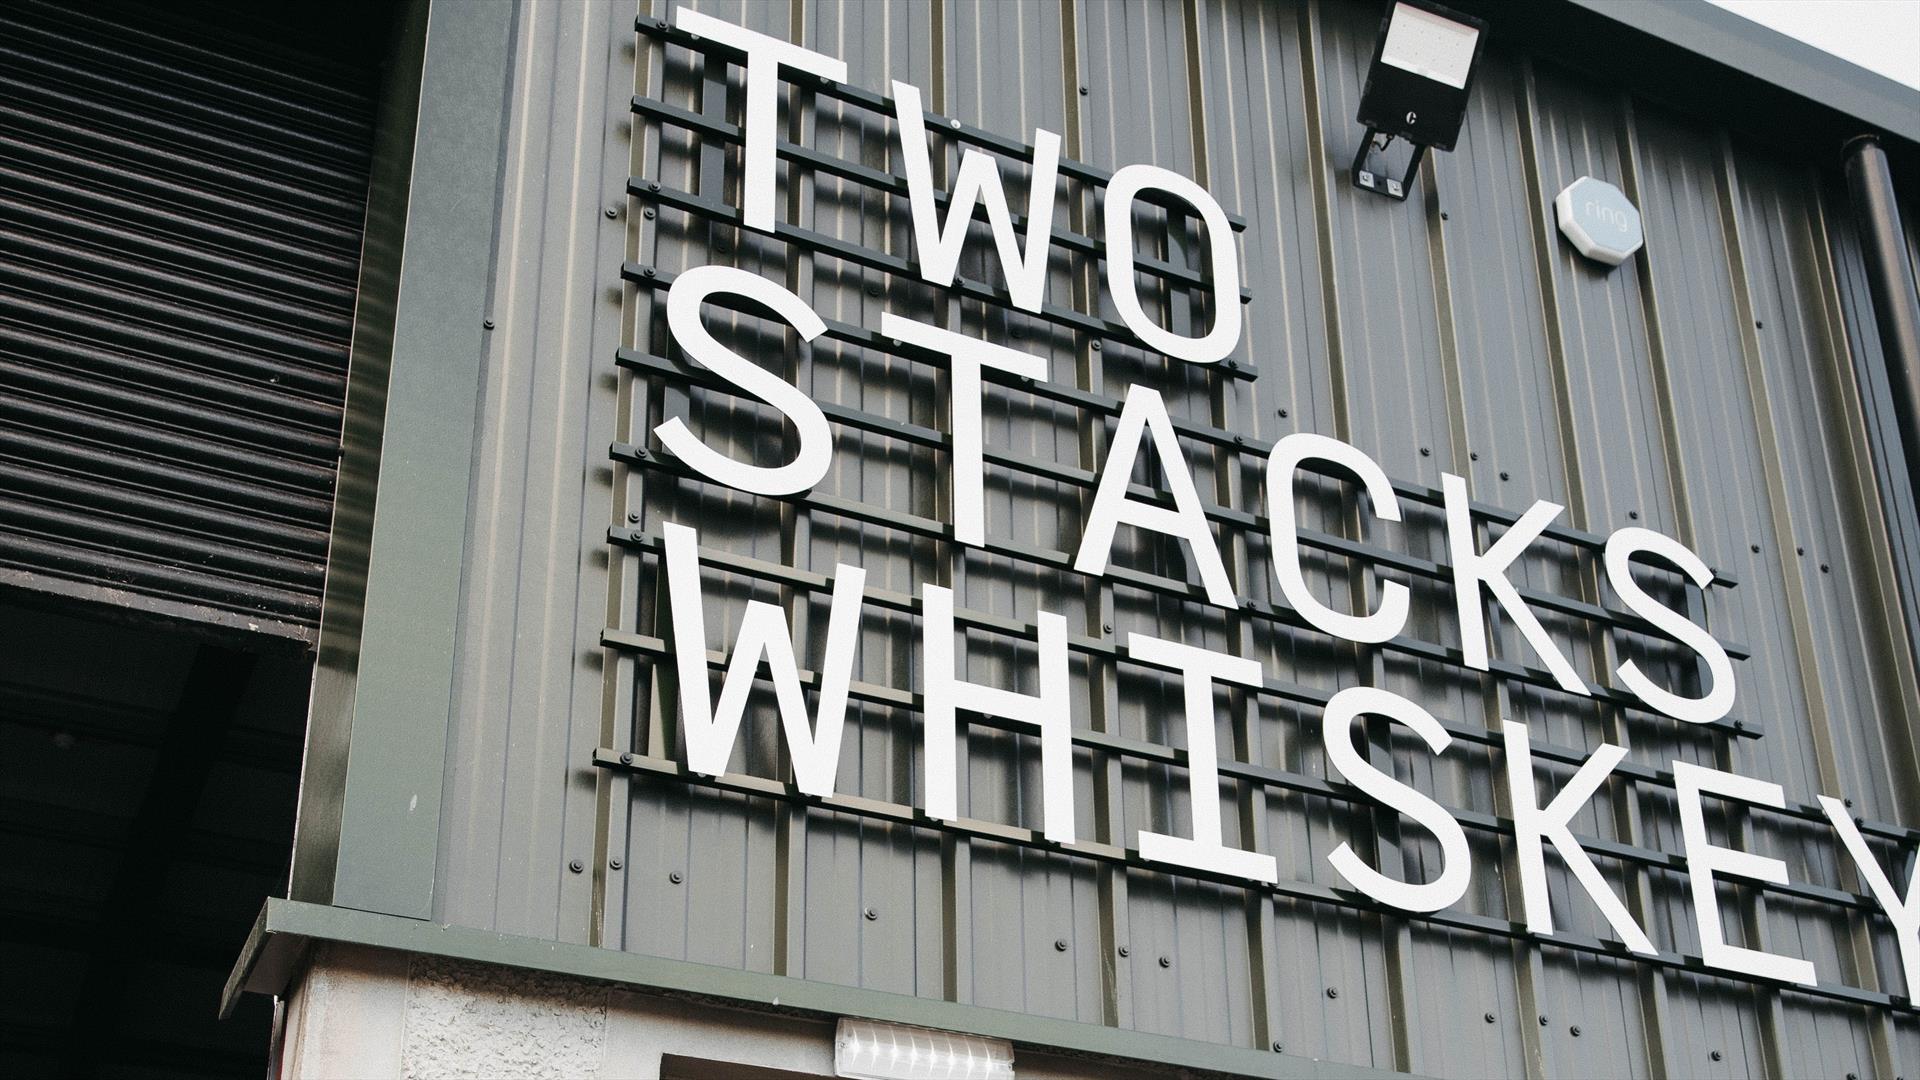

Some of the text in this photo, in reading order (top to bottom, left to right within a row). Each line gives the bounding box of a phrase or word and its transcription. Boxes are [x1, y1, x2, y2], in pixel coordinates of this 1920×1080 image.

[676, 8, 1241, 362] TWO
[1585, 201, 1628, 232] ring
[654, 266, 1735, 722] STACKS
[663, 521, 1920, 1007] WHISKEY
